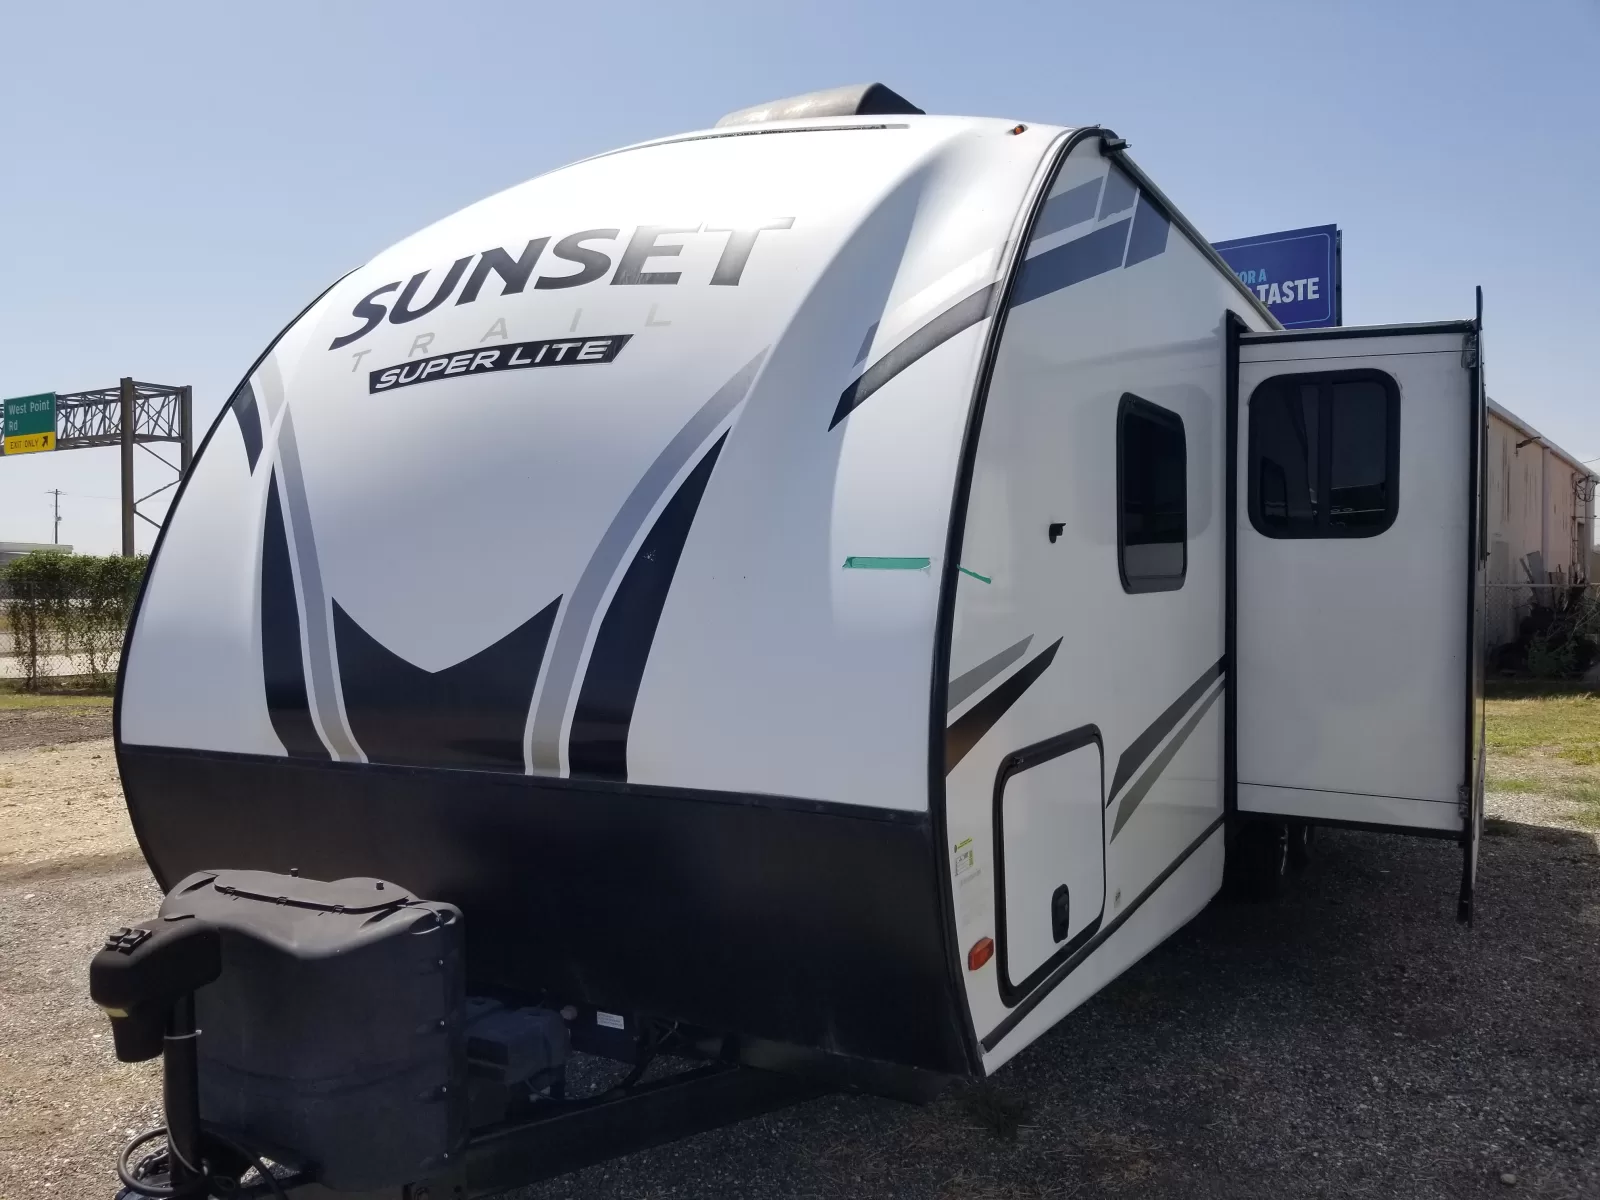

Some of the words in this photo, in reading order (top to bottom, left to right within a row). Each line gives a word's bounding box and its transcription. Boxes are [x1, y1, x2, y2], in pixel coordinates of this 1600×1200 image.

[328, 217, 796, 351] SUNSET
[1236, 270, 1256, 284] OR
[1258, 268, 1267, 282] A
[1256, 277, 1320, 305] TASTE
[351, 303, 672, 374] TRAIL
[375, 350, 501, 390] SUPER
[507, 340, 614, 367] LITE
[8, 403, 27, 415] West
[30, 400, 50, 412] Point
[8, 420, 18, 431] Rd
[10, 441, 22, 449] EXIT
[24, 439, 39, 448] ONLY
